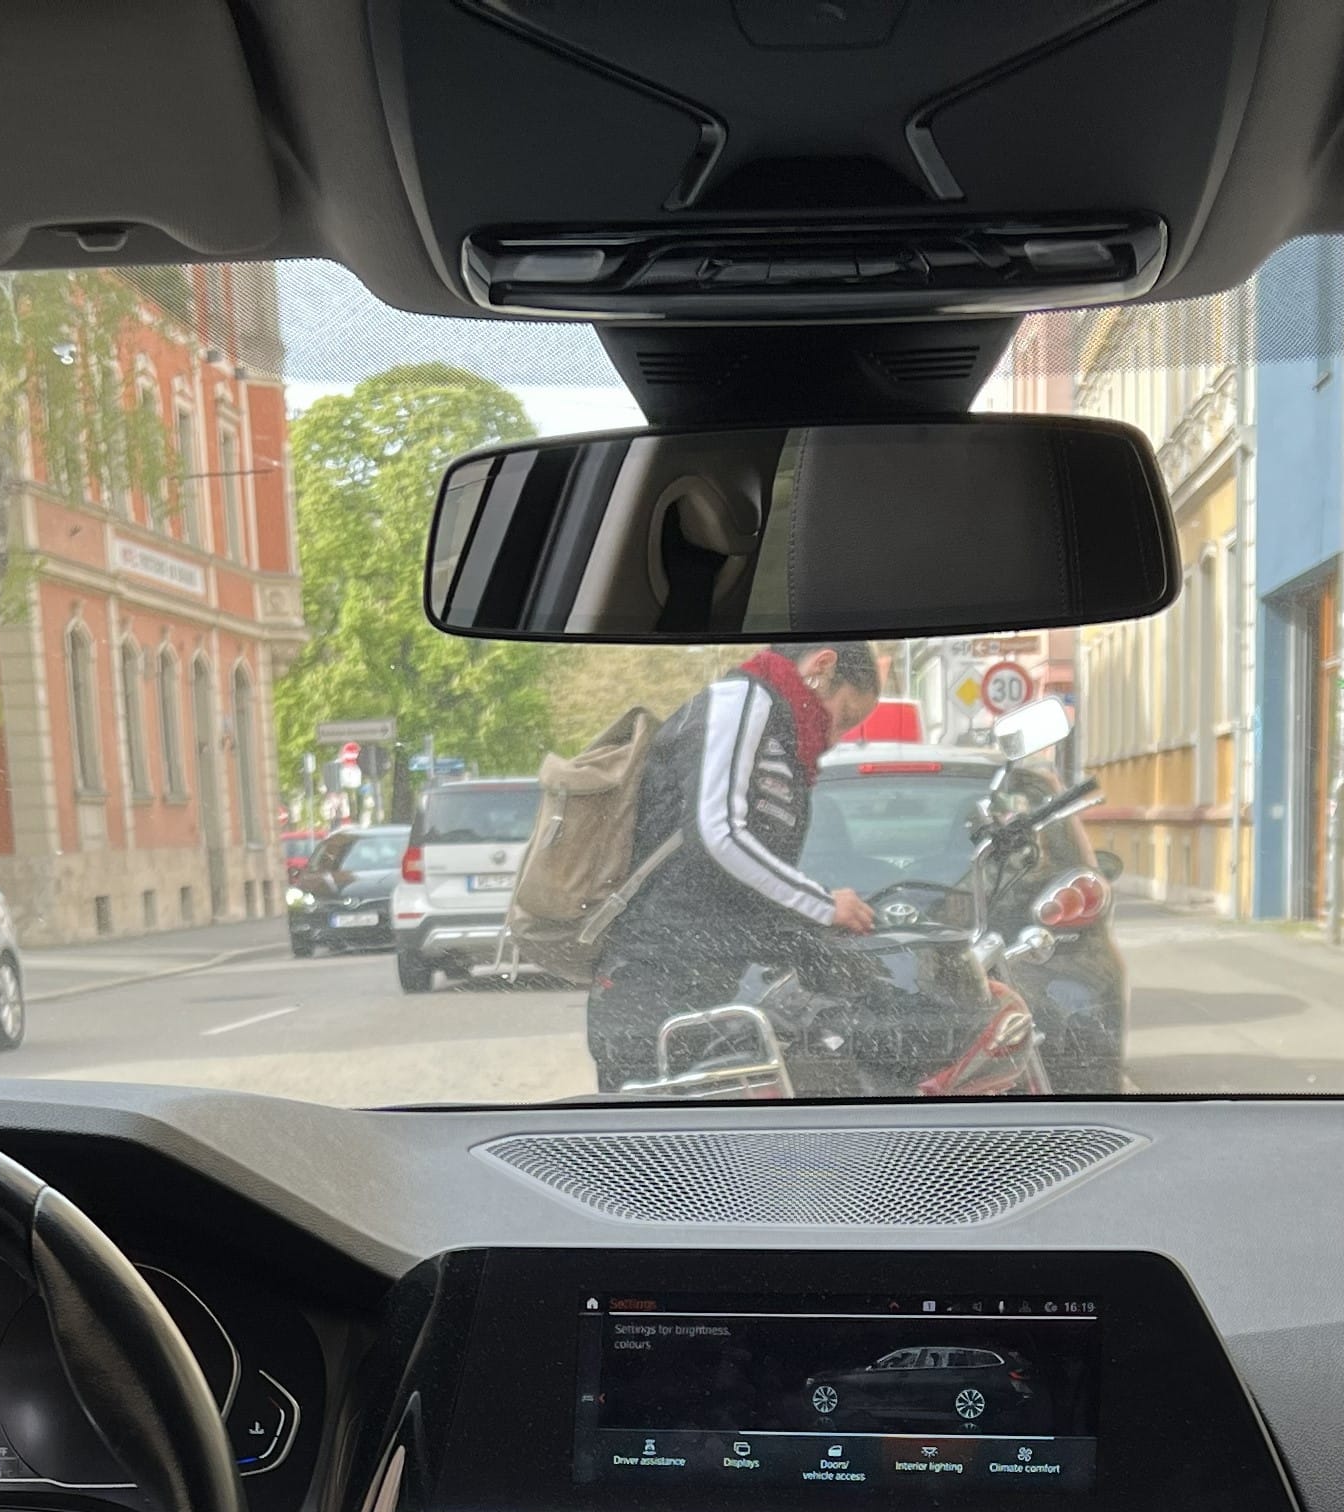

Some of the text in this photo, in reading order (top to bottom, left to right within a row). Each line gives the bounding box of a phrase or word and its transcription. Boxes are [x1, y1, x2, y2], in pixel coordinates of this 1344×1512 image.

[992, 678, 1022, 702] 30
[1064, 1302, 1095, 1313] 16:19
[614, 1324, 656, 1336] Settings
[658, 1325, 673, 1335] for
[613, 1456, 686, 1466] Driver assistance
[723, 1457, 760, 1468] Displays
[896, 1461, 963, 1473] Interior lighting
[989, 1463, 1061, 1474] Climate comfort
[803, 1471, 866, 1481] vehicle access
